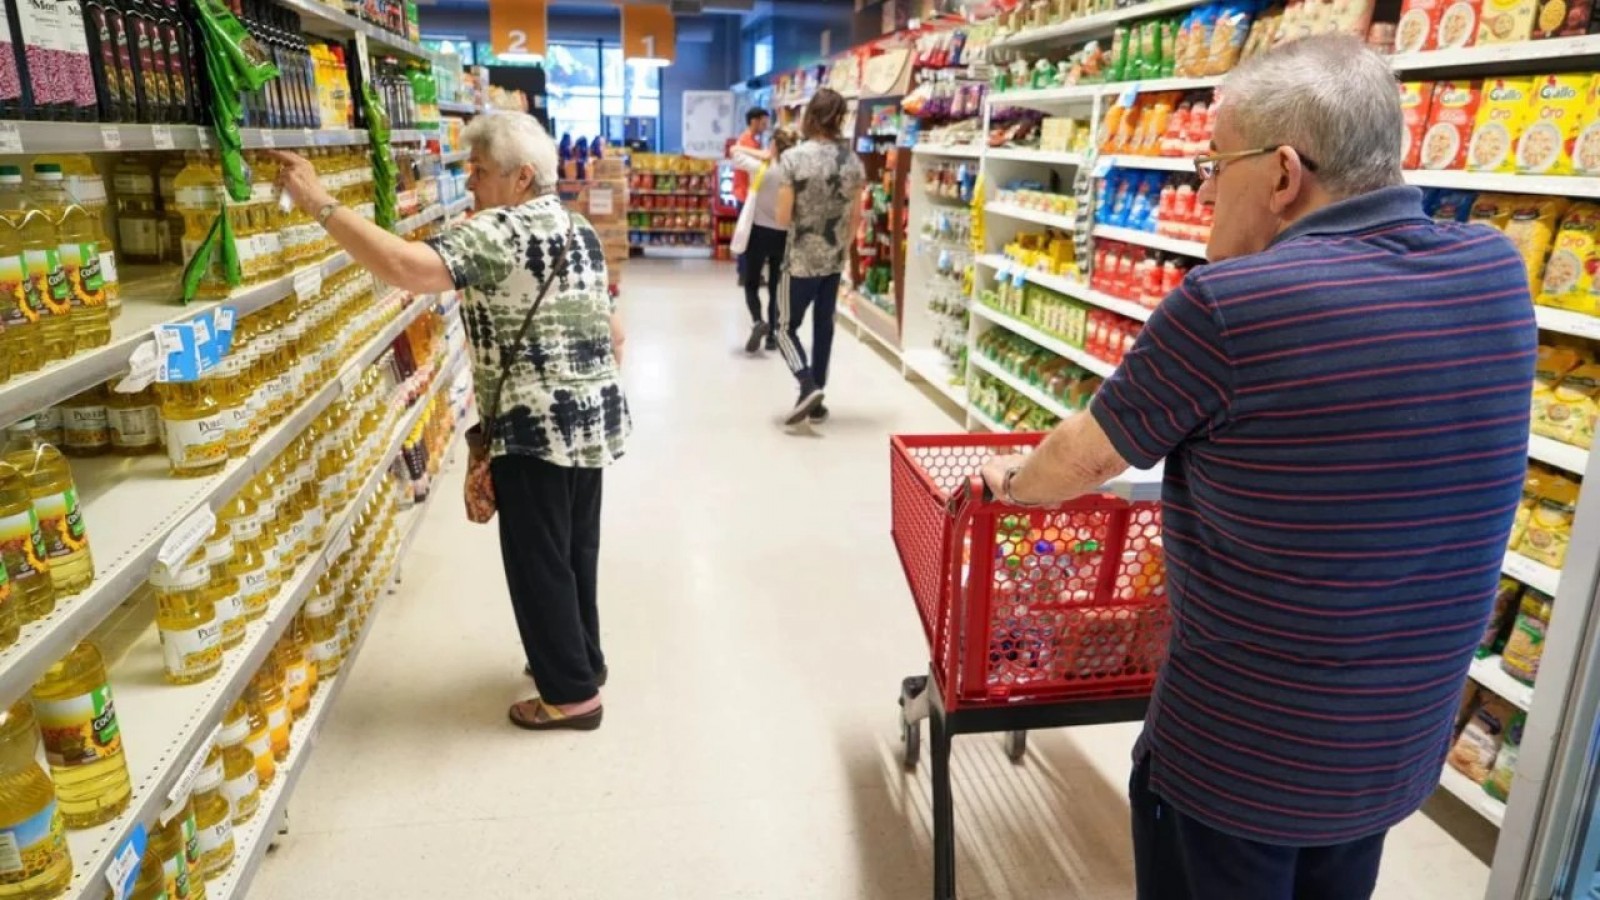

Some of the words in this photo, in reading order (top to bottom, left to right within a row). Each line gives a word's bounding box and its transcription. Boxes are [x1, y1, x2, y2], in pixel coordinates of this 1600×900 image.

[508, 30, 527, 53] 2
[641, 36, 656, 58] 1
[1541, 85, 1576, 99] Gallo
[1541, 105, 1563, 119] Oro
[1561, 235, 1586, 247] Oro
